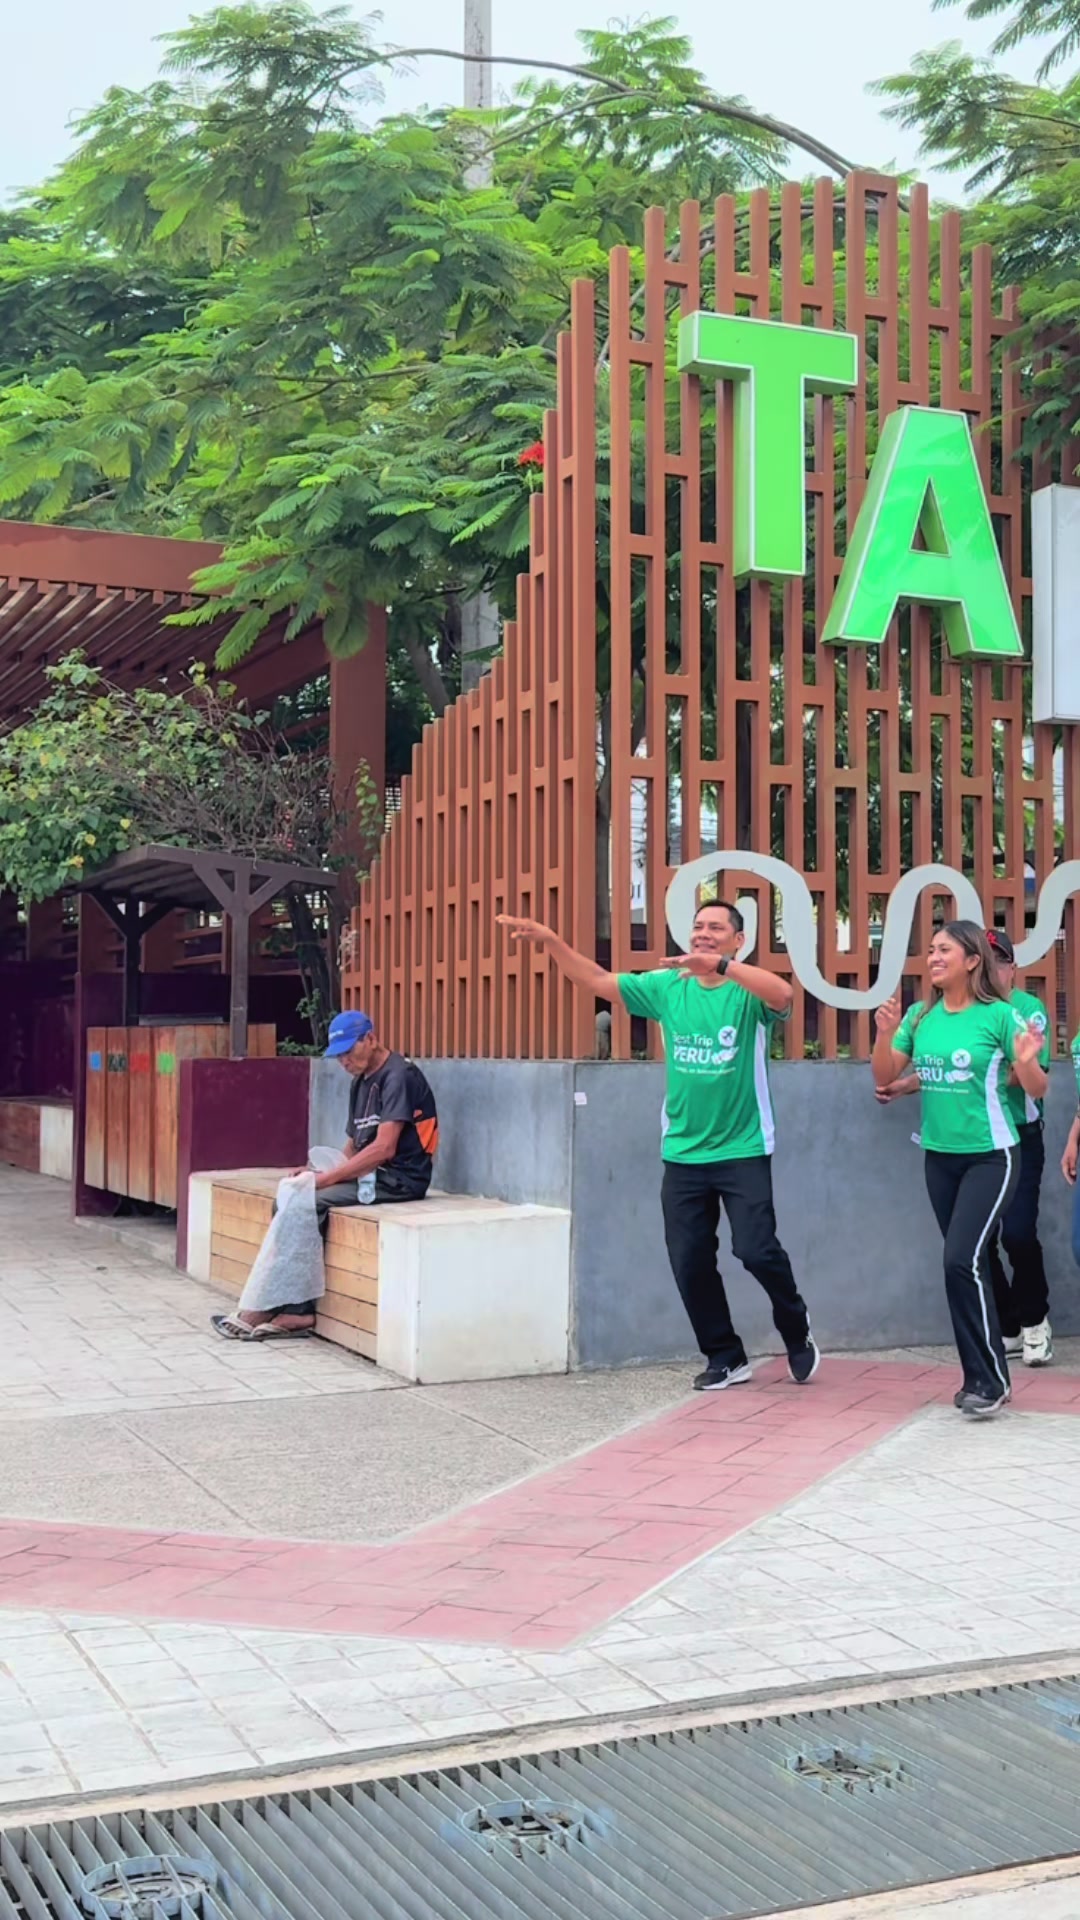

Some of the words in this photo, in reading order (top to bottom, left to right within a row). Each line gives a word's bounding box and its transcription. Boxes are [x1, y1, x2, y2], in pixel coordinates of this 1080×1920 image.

[692, 1033, 714, 1047] Trip
[923, 1054, 944, 1067] Trip
[916, 1067, 943, 1081] ERU
